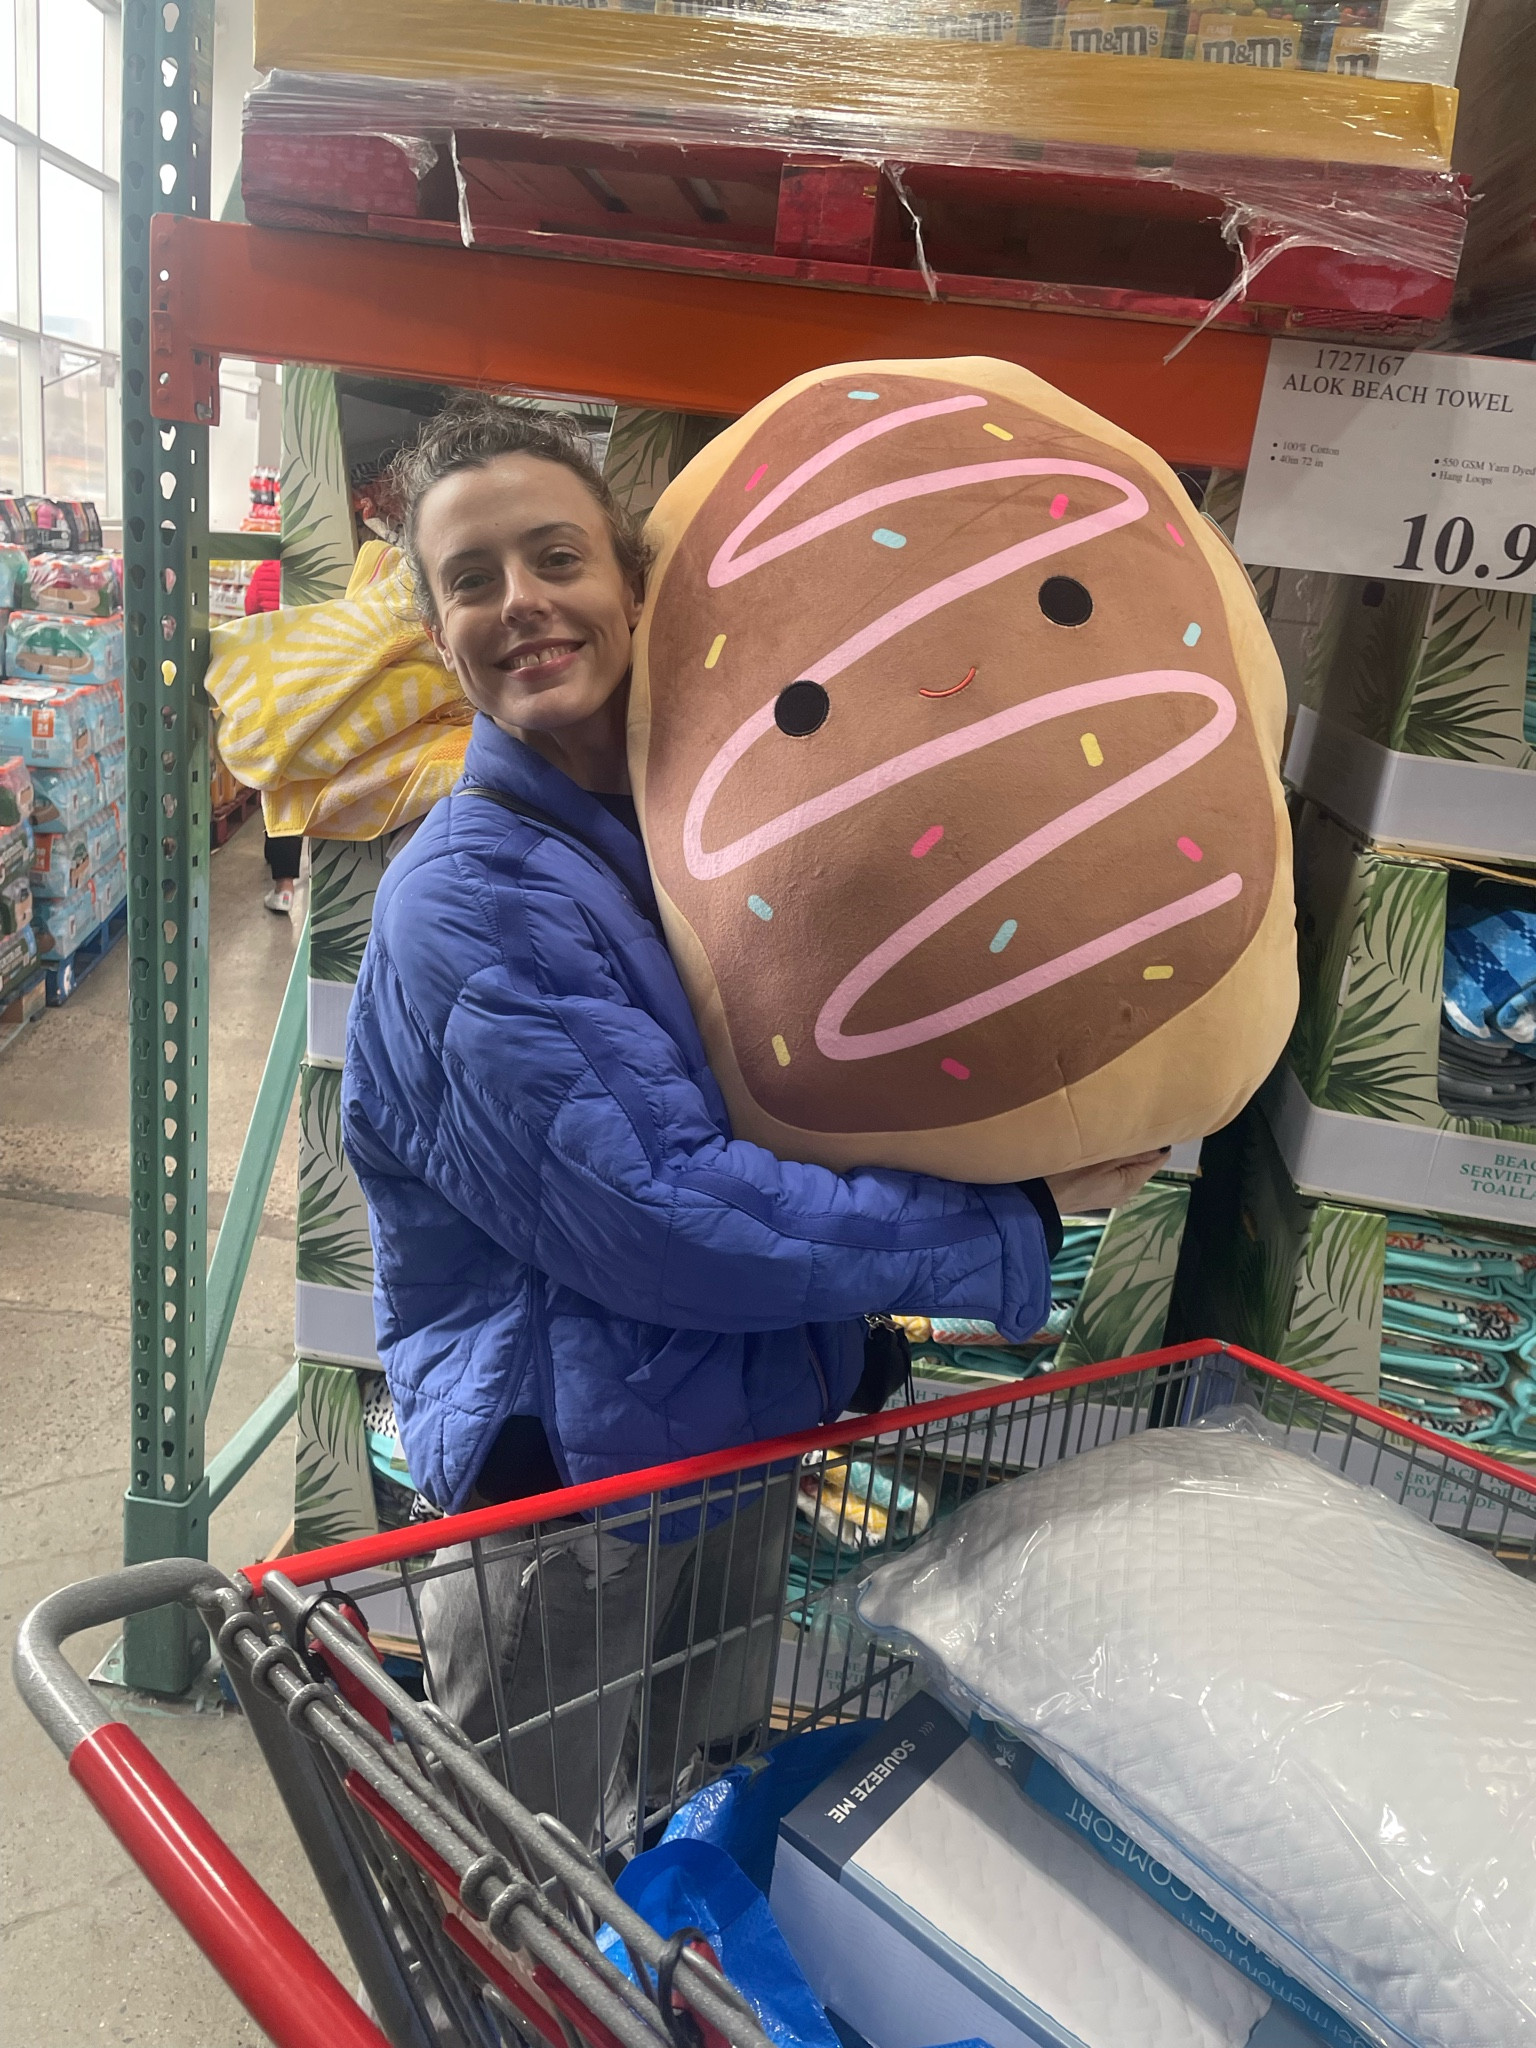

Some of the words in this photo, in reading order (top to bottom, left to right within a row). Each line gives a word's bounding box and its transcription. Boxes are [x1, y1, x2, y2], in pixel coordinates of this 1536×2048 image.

[1315, 349, 1405, 376] 1727167
[1282, 373, 1344, 396] ALOK
[1352, 379, 1429, 404] BEACH
[1436, 387, 1514, 413] TOWEL
[1283, 441, 1306, 453] 100%
[1310, 444, 1340, 456] Cotton
[1301, 456, 1313, 466] 72
[1439, 470, 1463, 483] Hang
[1465, 473, 1493, 486] Loops
[1442, 457, 1459, 468] 550
[1461, 459, 1485, 470] GSM
[1489, 462, 1510, 473] Yarn
[1393, 513, 1536, 580] 10.9
[1475, 1497, 1497, 1510] DE
[849, 1739, 916, 1801] SQUEEZE
[826, 1797, 857, 1824] ME
[1065, 1798, 1193, 1902] COMFORT
[1238, 1955, 1329, 2029] memory
